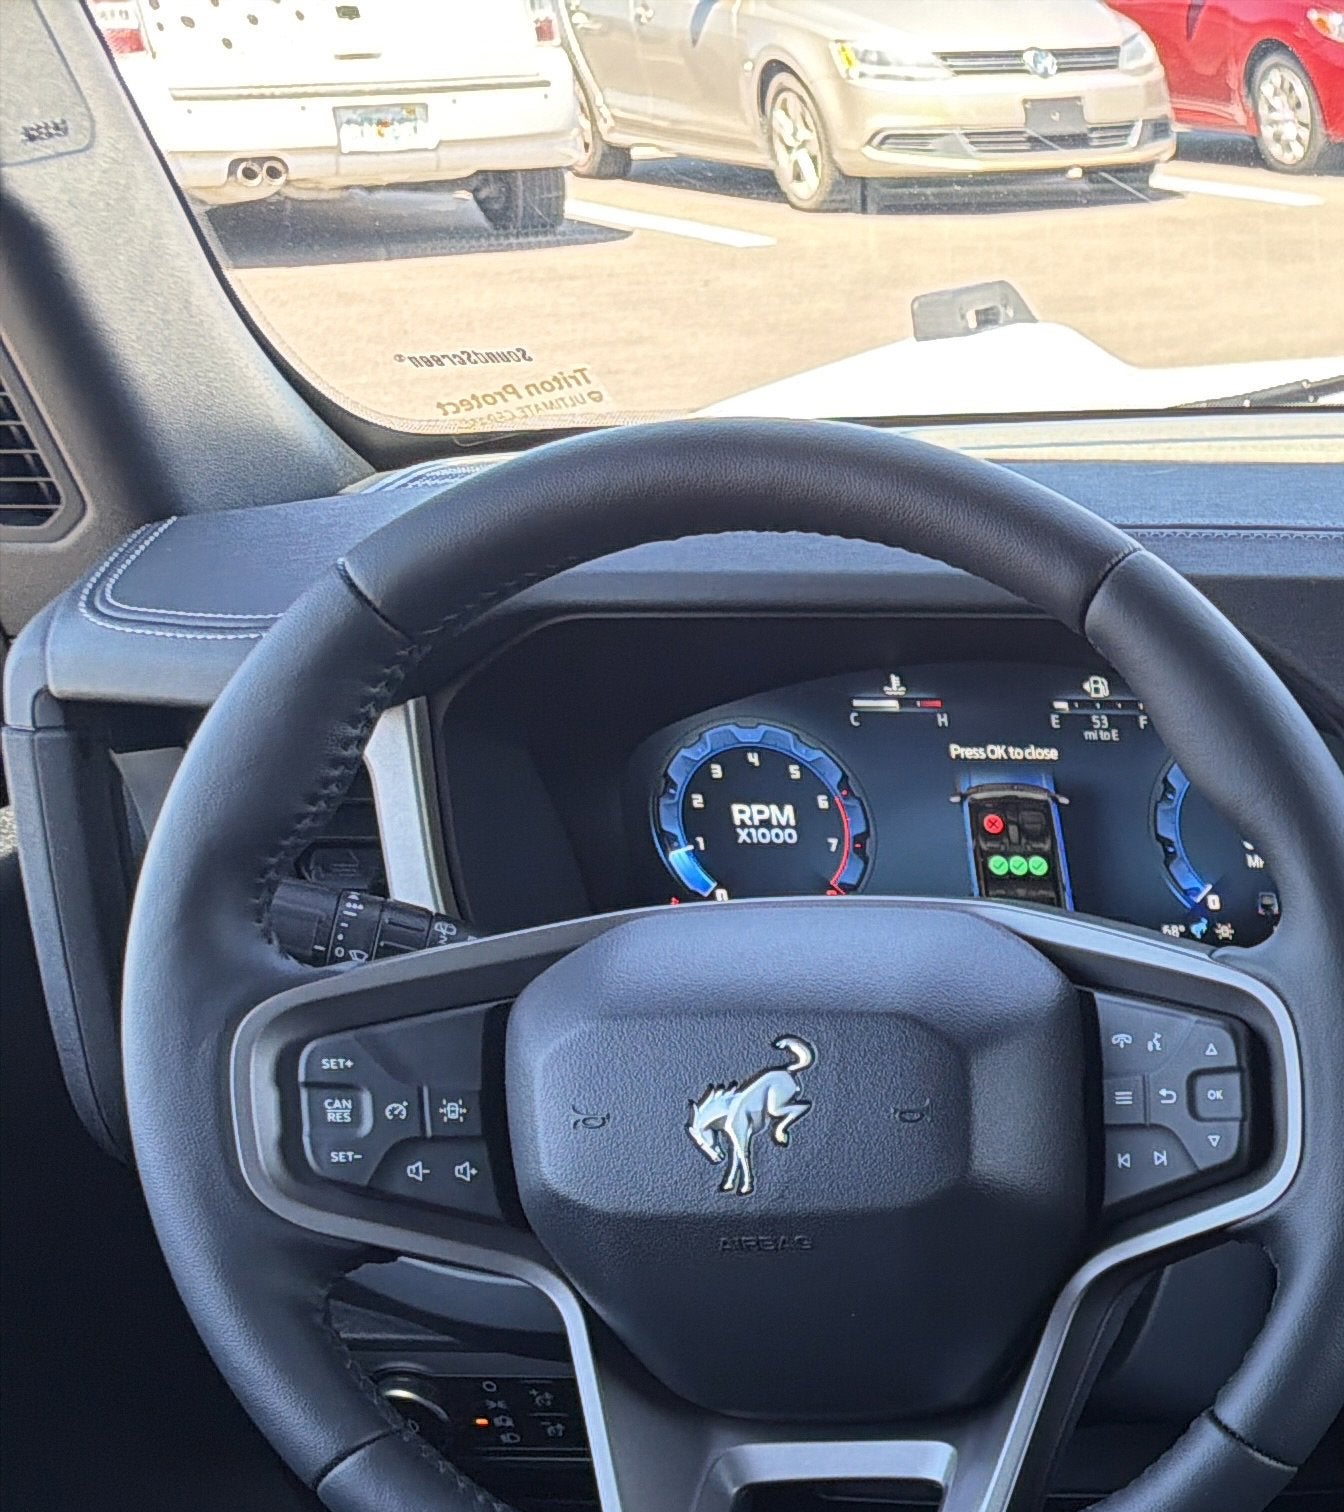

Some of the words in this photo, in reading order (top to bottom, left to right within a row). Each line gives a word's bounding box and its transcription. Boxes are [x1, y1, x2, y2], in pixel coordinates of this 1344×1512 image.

[850, 712, 860, 726] C
[937, 713, 948, 727] H
[1051, 715, 1060, 728] E
[1091, 715, 1109, 728] 53
[1138, 716, 1148, 729] F
[747, 752, 760, 766] 4
[950, 744, 986, 760] Press
[987, 745, 1008, 760] OK
[1009, 745, 1023, 760] to
[1024, 745, 1059, 760] close
[710, 764, 722, 779] 3
[788, 765, 800, 779] 5
[691, 794, 704, 808] 2
[817, 794, 829, 809] 6
[730, 803, 796, 827] RPM
[736, 828, 798, 844] X1000
[695, 837, 705, 850] 1
[827, 838, 838, 852] 7
[1206, 894, 1221, 911] 0
[1207, 1089, 1223, 1100] OK
[324, 1098, 352, 1109] CAN
[327, 1112, 352, 1123] RES
